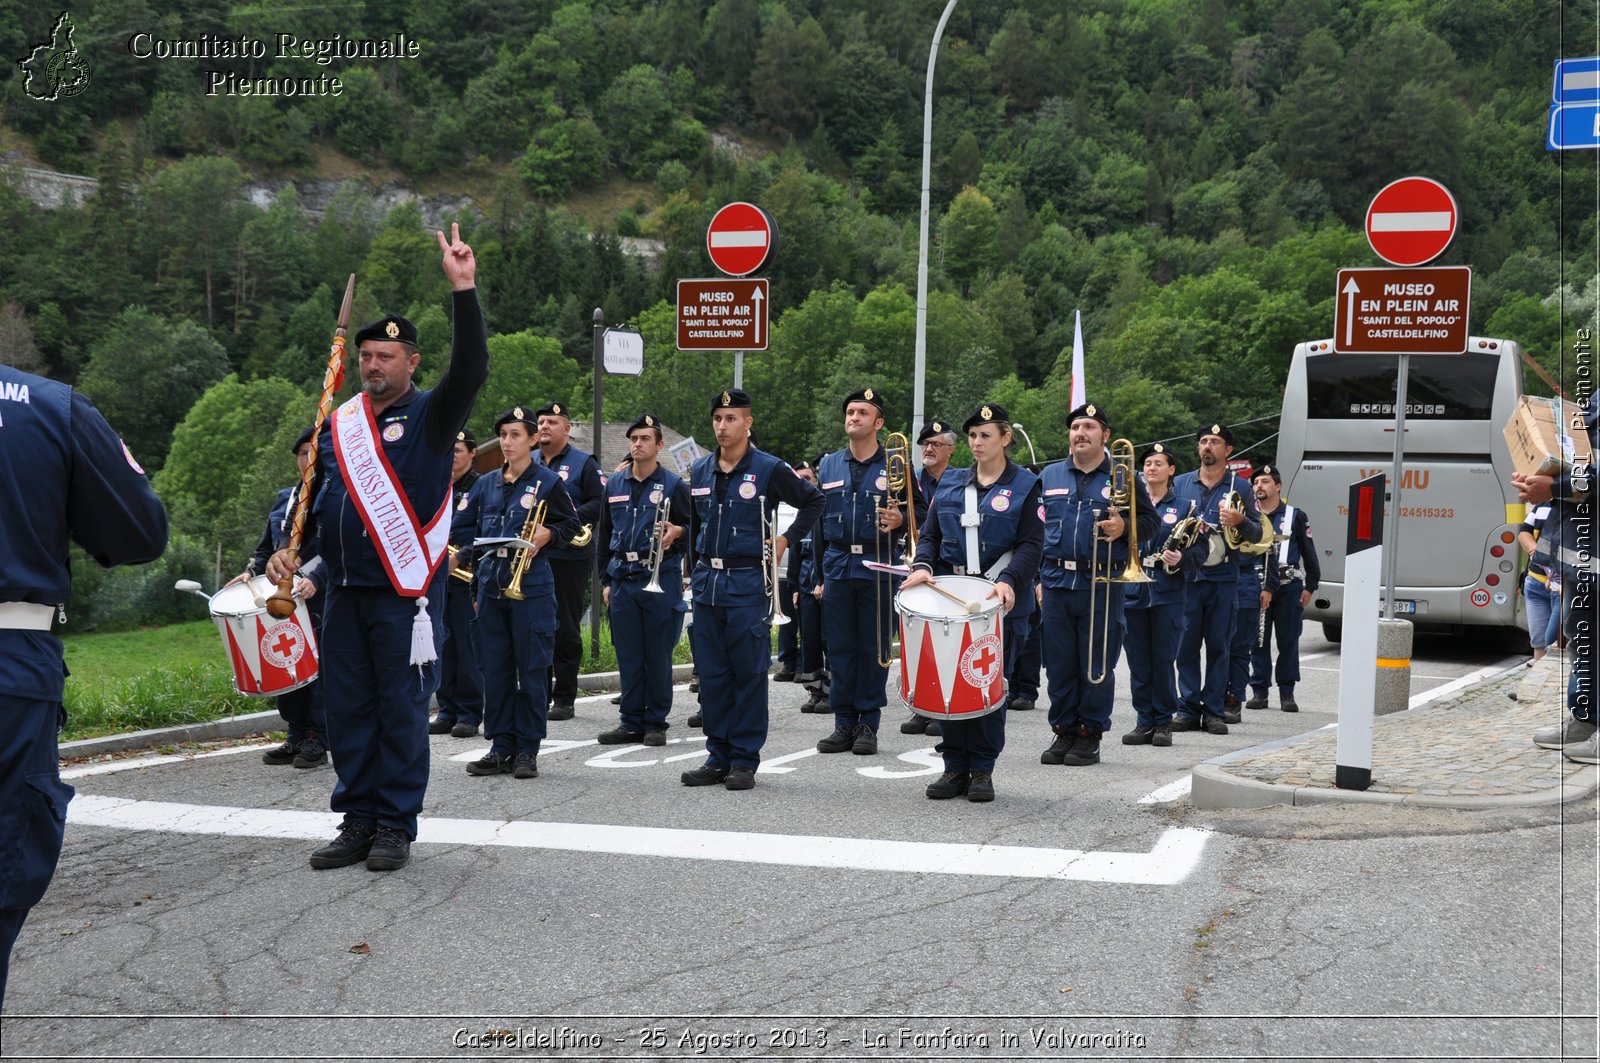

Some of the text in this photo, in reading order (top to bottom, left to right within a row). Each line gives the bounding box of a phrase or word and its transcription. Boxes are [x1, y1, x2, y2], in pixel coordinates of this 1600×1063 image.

[1384, 283, 1435, 296] MUSEO
[699, 292, 734, 303] MUSEO
[683, 305, 750, 316] EN PLEIN AIR
[1360, 300, 1459, 312] EN PLEIN AIR
[707, 319, 720, 327] DEL
[1394, 316, 1413, 325] DEL
[688, 330, 744, 338] CASTELDELFINO
[1367, 329, 1449, 339] CASTELDELFINO
[343, 423, 370, 465] CROCE
[356, 457, 389, 506] ROSSA
[374, 500, 418, 570] ITALIANA
[1474, 594, 1488, 602] 100
